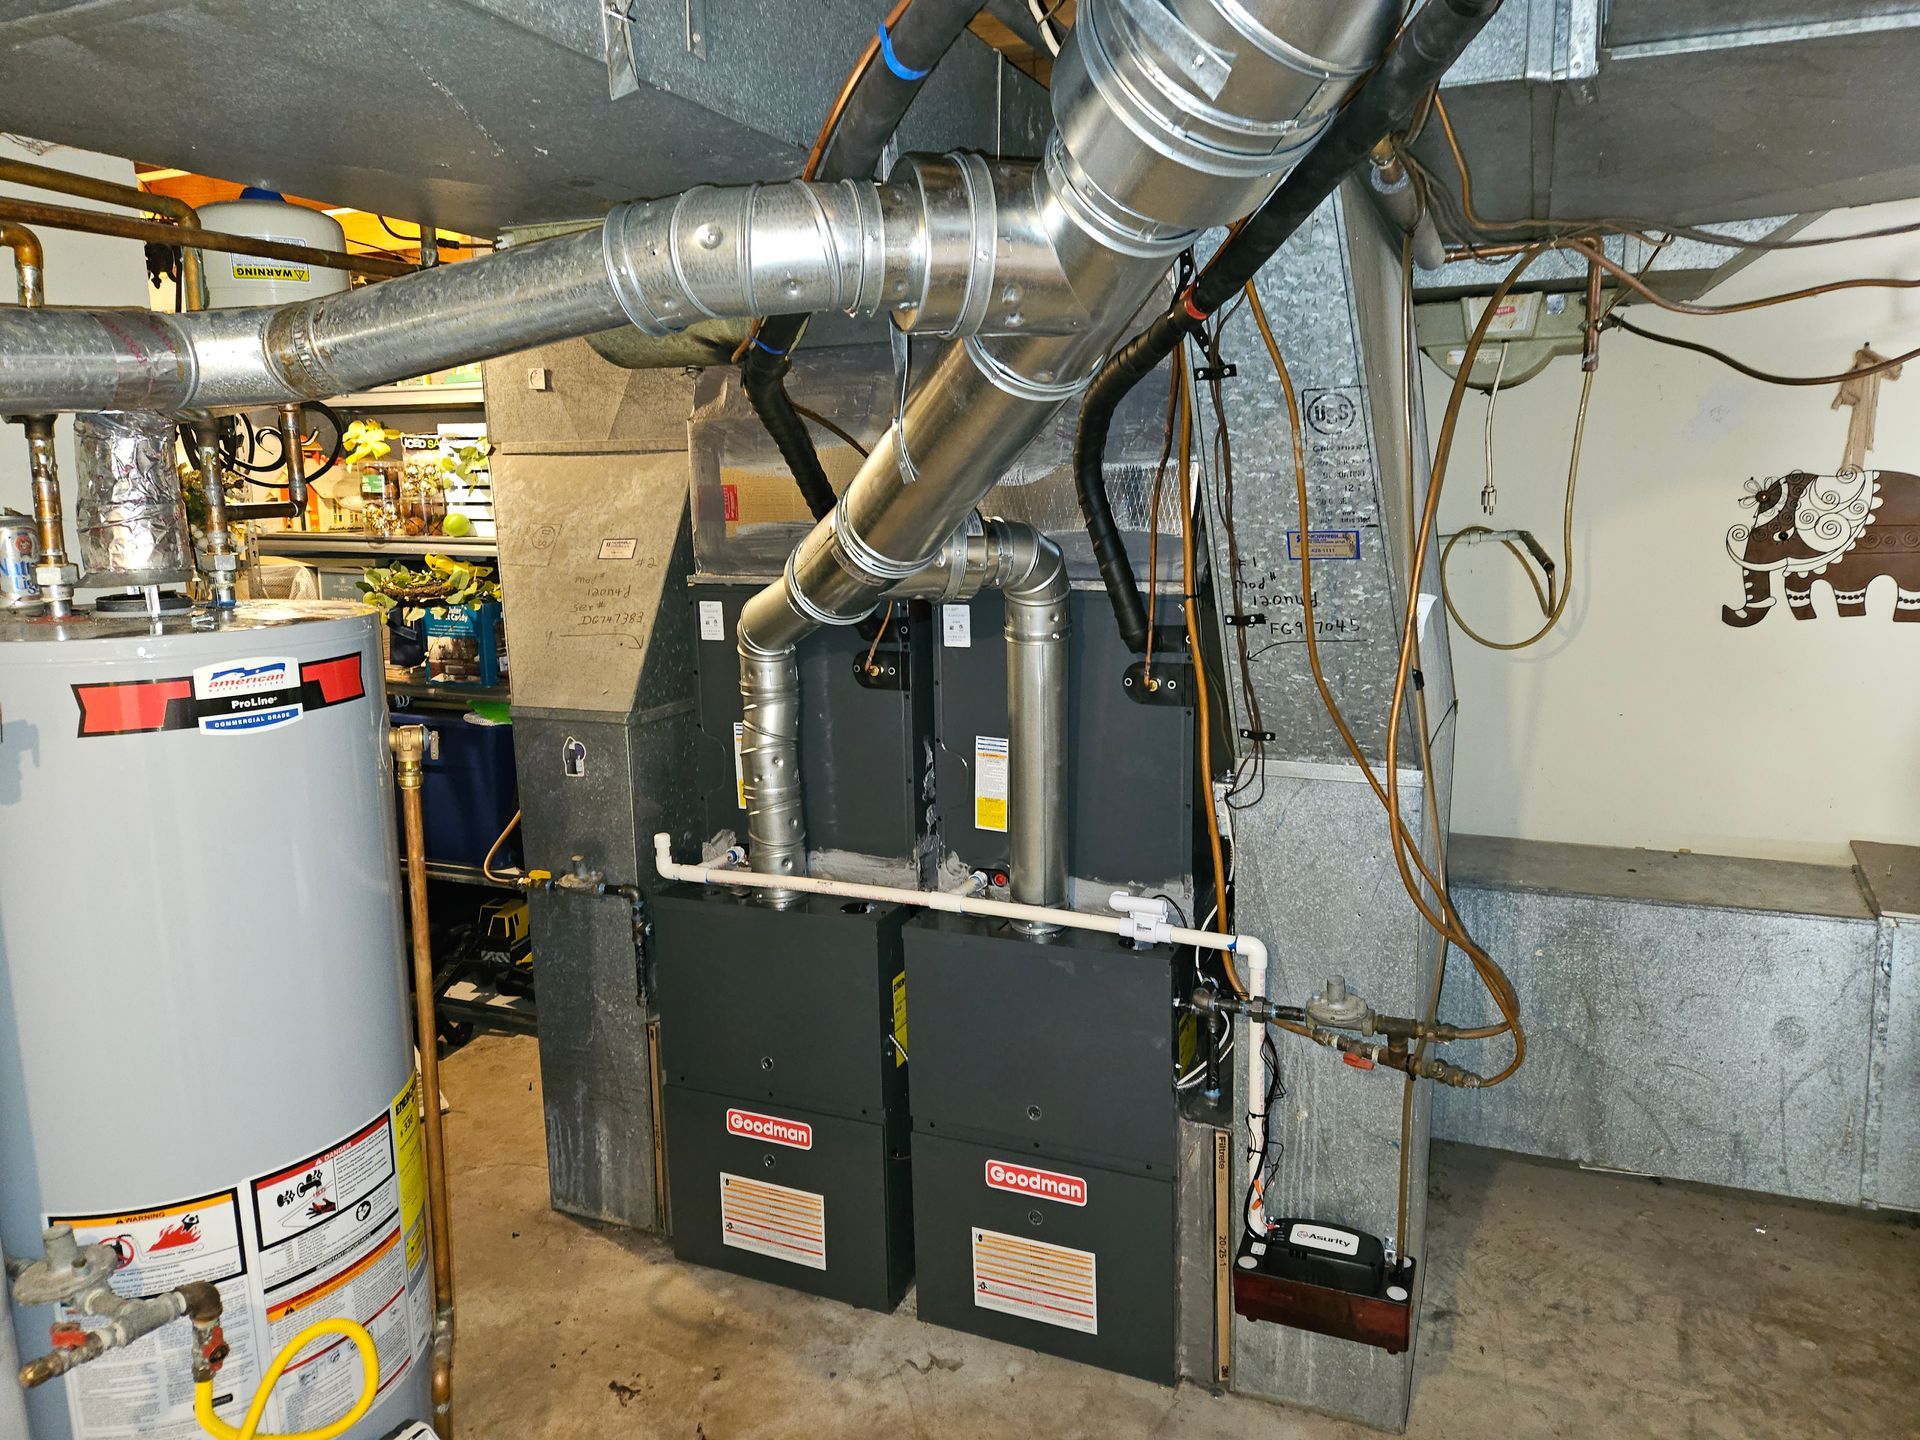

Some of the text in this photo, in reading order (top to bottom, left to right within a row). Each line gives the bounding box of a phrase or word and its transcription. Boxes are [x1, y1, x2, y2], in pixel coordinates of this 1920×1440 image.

[237, 267, 293, 277] WARNING
[208, 673, 284, 688] american
[214, 712, 290, 728] COMMERCIAL GRADE
[730, 1113, 808, 1143] Goodman
[324, 1142, 352, 1161] DANGER
[1218, 1136, 1227, 1169] Filtrete
[990, 1166, 1082, 1198] Goodman
[124, 1211, 166, 1224] WARNING
[1308, 1233, 1351, 1248] Asurity
